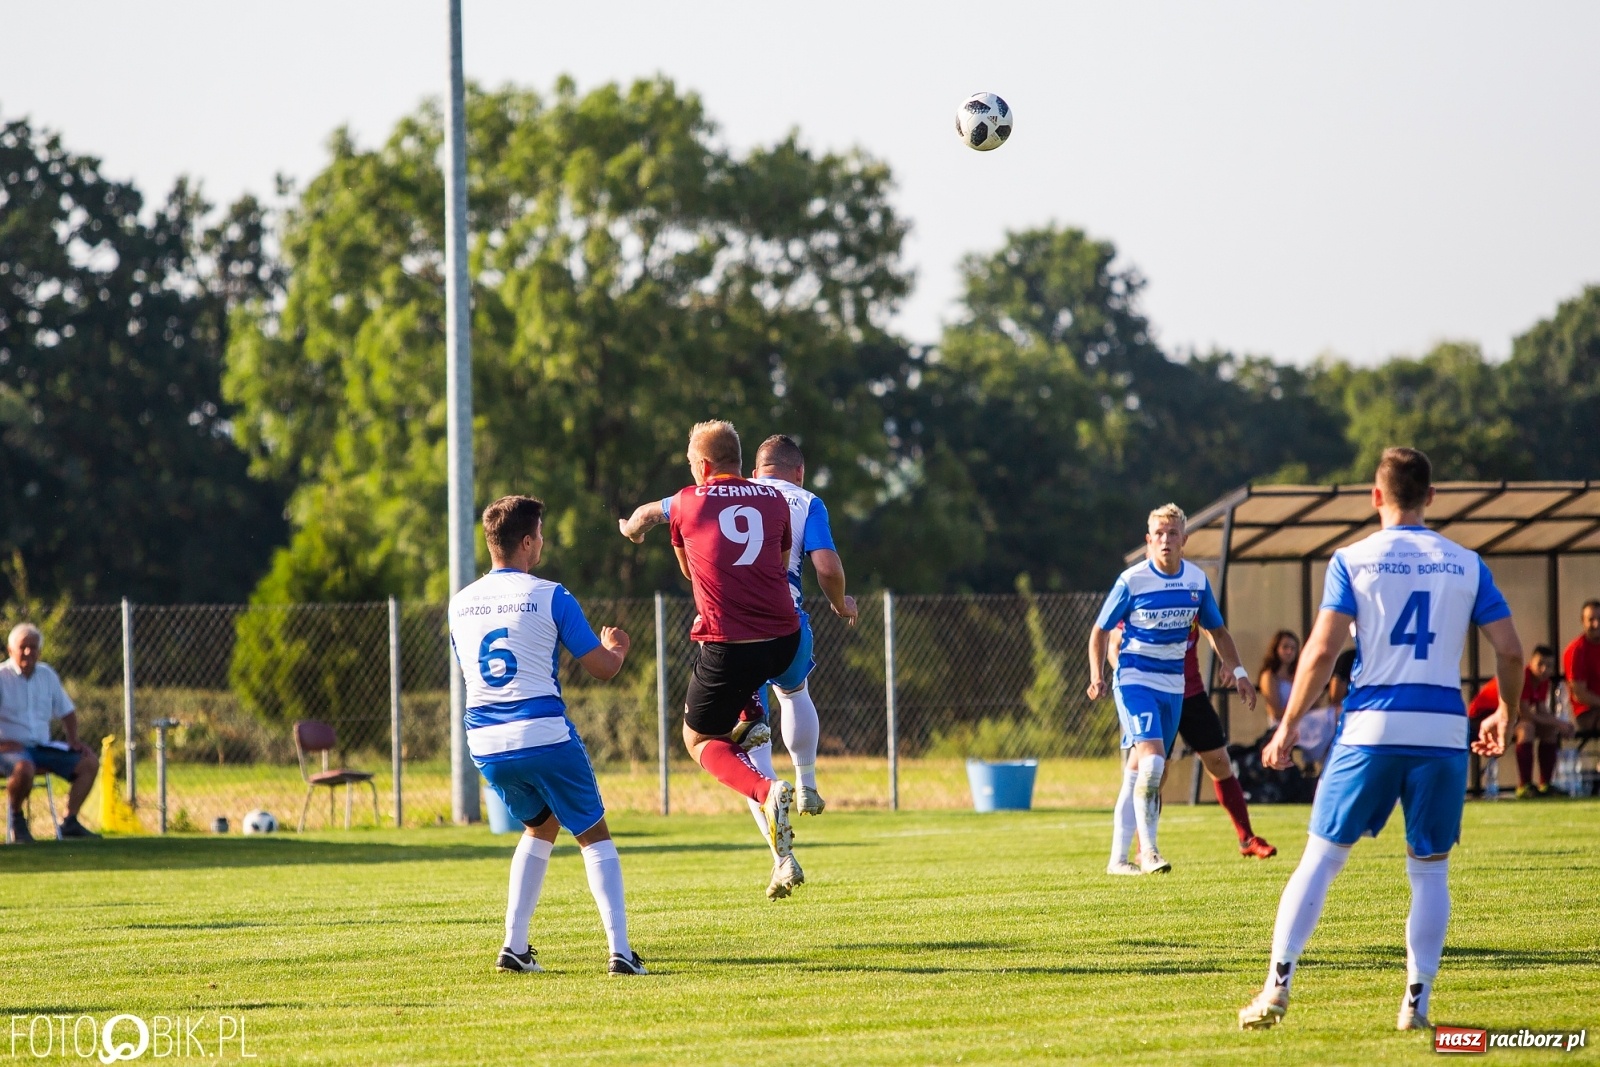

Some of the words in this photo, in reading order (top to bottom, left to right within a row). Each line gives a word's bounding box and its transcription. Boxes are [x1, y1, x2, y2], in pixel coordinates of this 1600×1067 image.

[695, 485, 777, 498] CZERNICA
[718, 504, 764, 566] 9
[1363, 562, 1411, 575] NAPRZÓD
[1418, 563, 1465, 576] BORUCIN
[497, 602, 538, 614] BORUCIN
[1141, 611, 1159, 620] MW
[1161, 609, 1192, 619] SPORT
[1389, 591, 1436, 660] 4
[478, 627, 518, 688] 6
